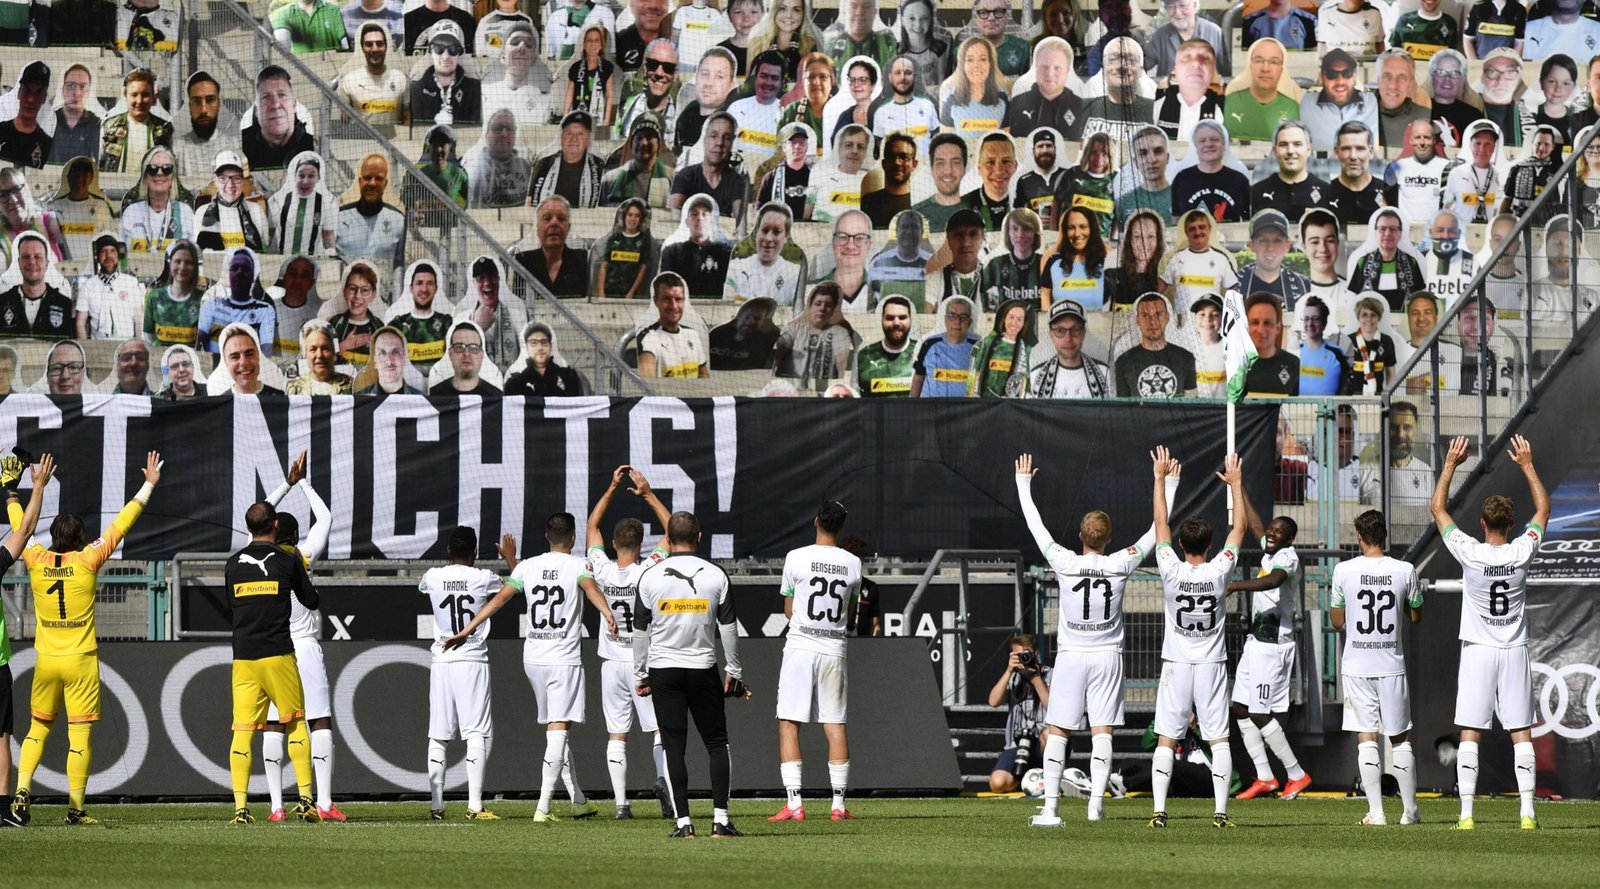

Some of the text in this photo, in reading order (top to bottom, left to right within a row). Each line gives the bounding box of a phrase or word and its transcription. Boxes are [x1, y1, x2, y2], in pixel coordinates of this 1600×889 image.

[1404, 175, 1439, 187] erdgas
[231, 392, 738, 560] NICHTS!
[43, 567, 75, 578] SOMMER
[811, 562, 849, 577] BENSEBAINI
[1178, 580, 1215, 594] HOFMANN
[1361, 574, 1392, 586] NEUHAUS
[1483, 566, 1516, 577] KRAMER
[47, 579, 67, 620] 1
[439, 593, 476, 637] 16
[531, 584, 567, 630] 22
[611, 599, 634, 633] 7
[674, 603, 708, 611] Postbank
[807, 576, 848, 623] 25
[1072, 577, 1113, 620] 17
[1175, 593, 1217, 632] 23
[1356, 589, 1396, 635] 32
[1490, 579, 1510, 617] 6
[1256, 683, 1271, 700] 10
